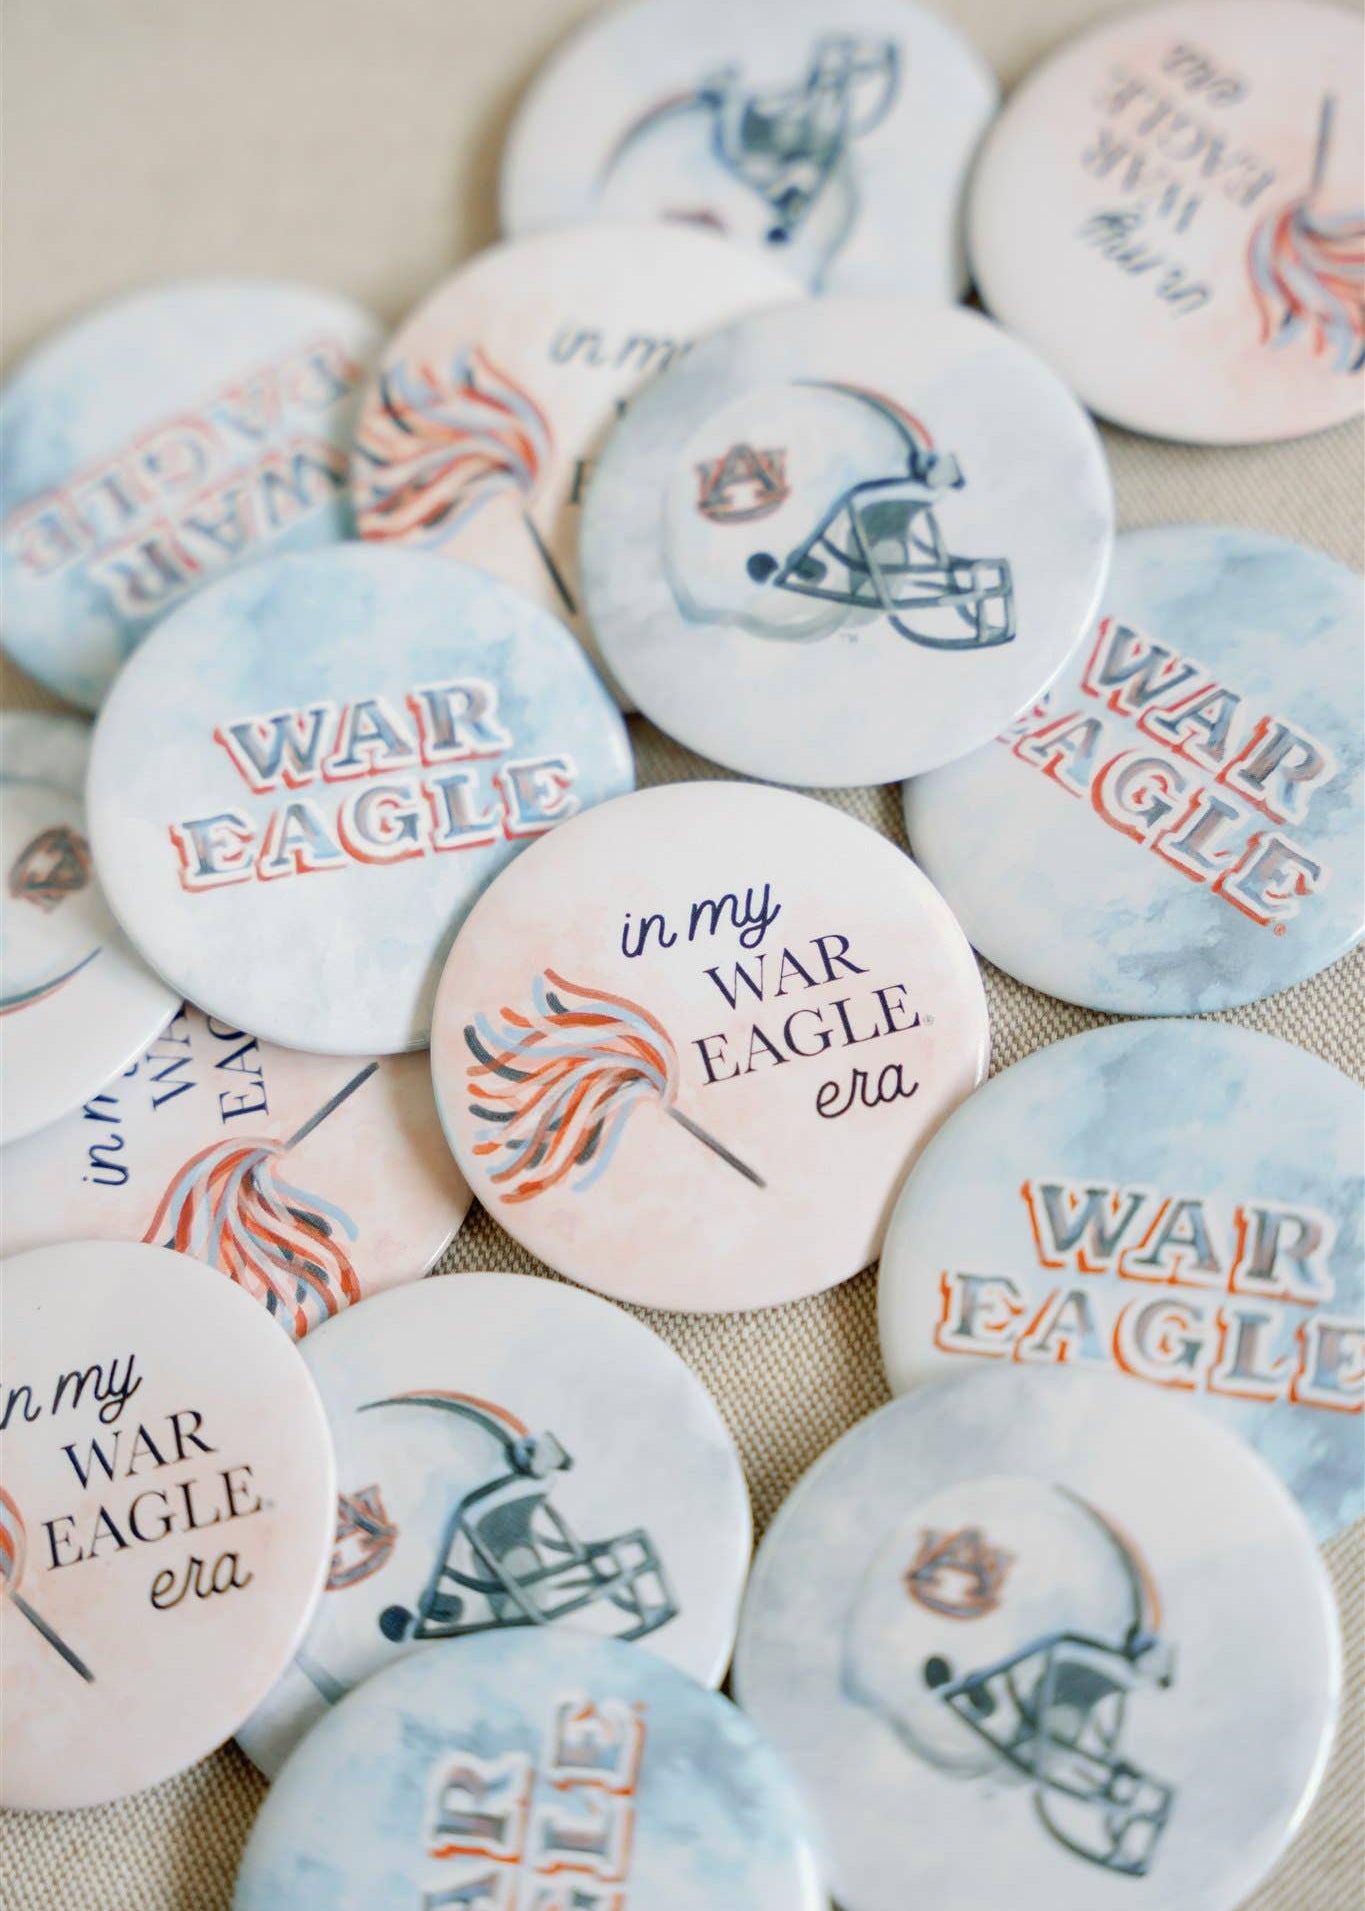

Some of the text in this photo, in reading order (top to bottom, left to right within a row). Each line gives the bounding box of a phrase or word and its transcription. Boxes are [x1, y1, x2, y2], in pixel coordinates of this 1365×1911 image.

[213, 682, 510, 795] WAR
[1081, 615, 1334, 825] WAR
[169, 757, 578, 893] EAGLE
[996, 690, 1330, 928] AGLE
[621, 883, 781, 958] in my
[702, 933, 871, 1011] WAR
[145, 1001, 198, 1112] WA
[691, 983, 921, 1087] EAGLE
[816, 1063, 920, 1119] era
[82, 1133, 130, 1186] in
[1020, 1179, 1333, 1307] WAR
[52, 1354, 143, 1425] my
[934, 1270, 1365, 1413] EAGLE
[60, 1409, 219, 1491] WAR
[41, 1464, 265, 1572] EAGLE
[150, 1550, 256, 1611] era
